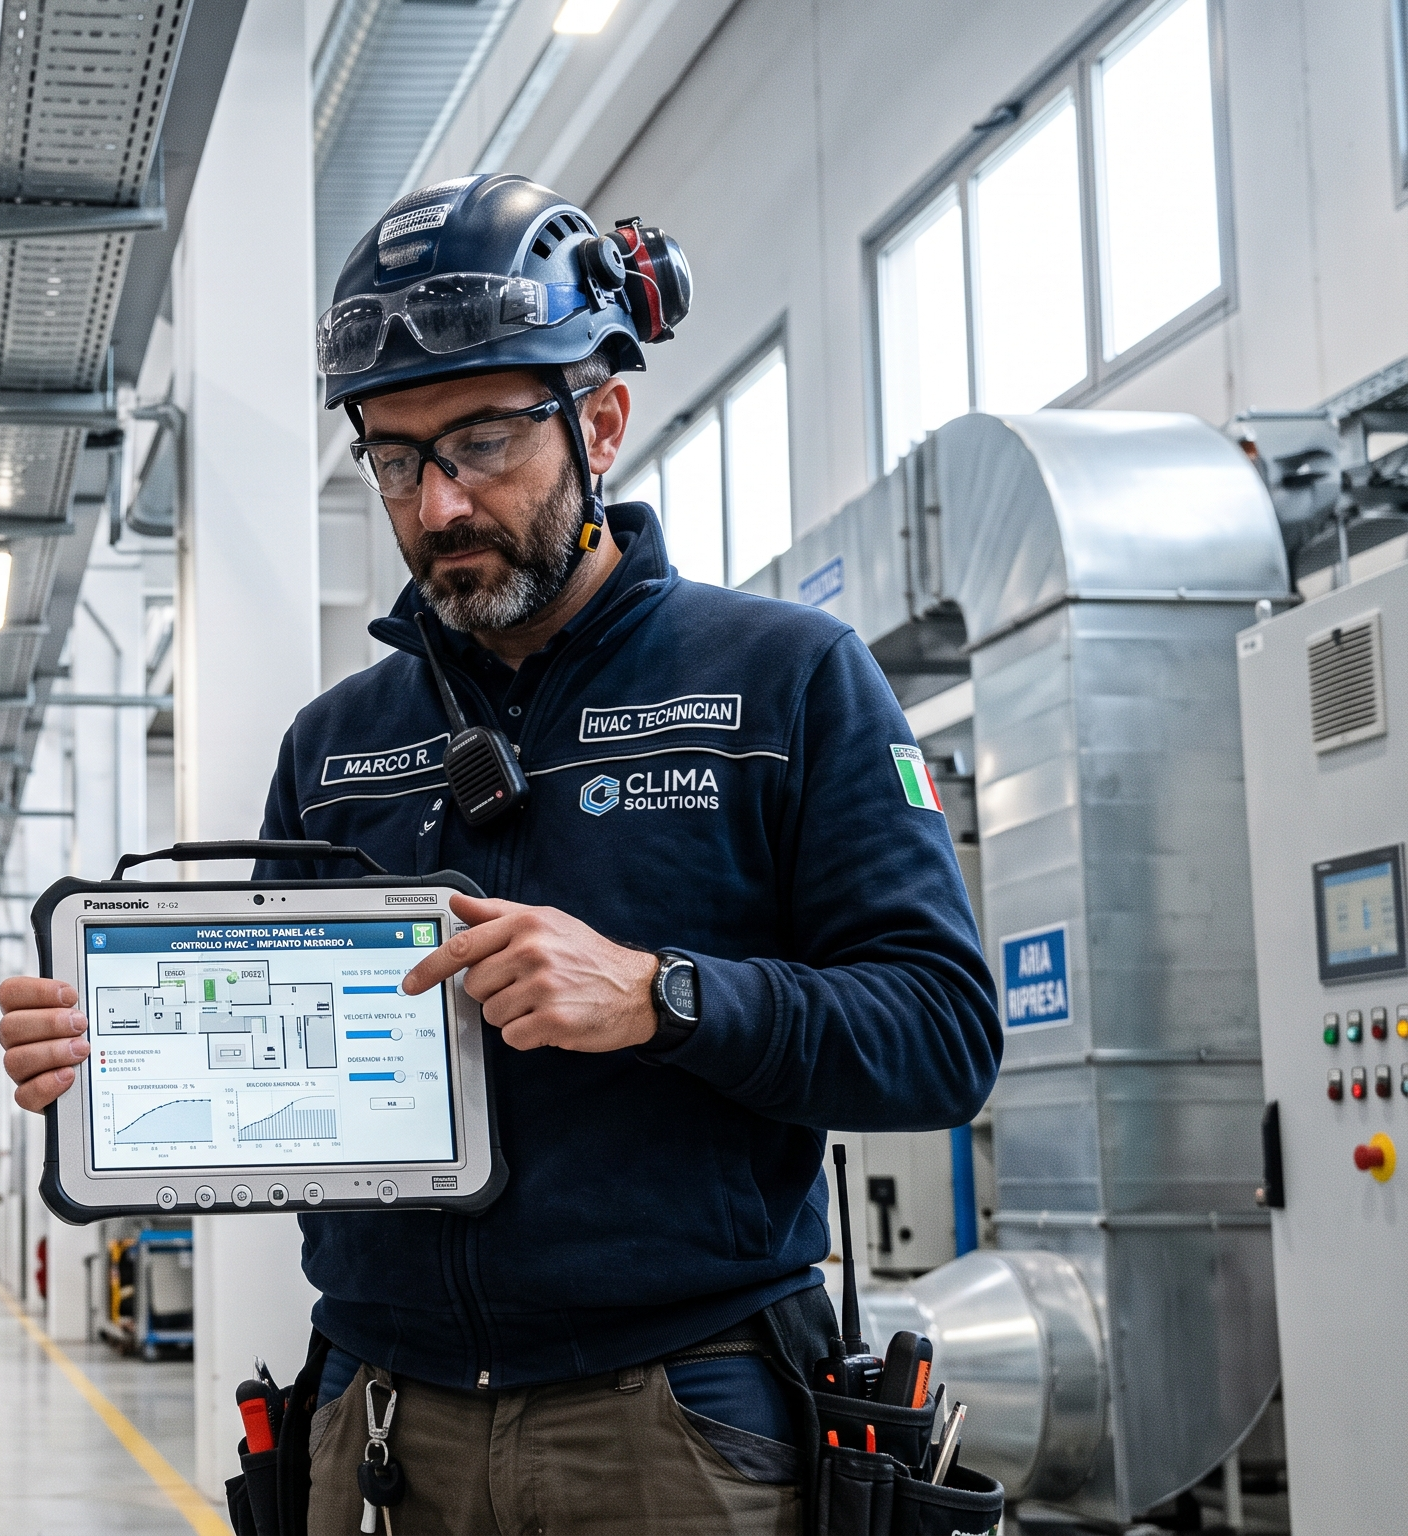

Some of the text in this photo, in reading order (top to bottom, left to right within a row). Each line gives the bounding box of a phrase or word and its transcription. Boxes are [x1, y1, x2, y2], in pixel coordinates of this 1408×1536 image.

[587, 702, 733, 734] HVAC TECHNICIAN
[343, 749, 430, 775] MARCO R.
[625, 768, 719, 795] CLIMA
[624, 795, 720, 811] SOLUTIONS
[83, 898, 150, 910] Panasonic
[196, 929, 223, 938] HVAC
[225, 929, 270, 938] CONTROL
[272, 928, 303, 937] PANEL
[170, 941, 222, 950] CONTROLLO
[224, 940, 249, 949] HVAC
[256, 939, 302, 948] IMPIANTO
[346, 938, 354, 947] A
[1018, 940, 1053, 978] ARIA
[1007, 979, 1067, 1020] RIPRESA
[374, 1012, 402, 1020] VENTOLA
